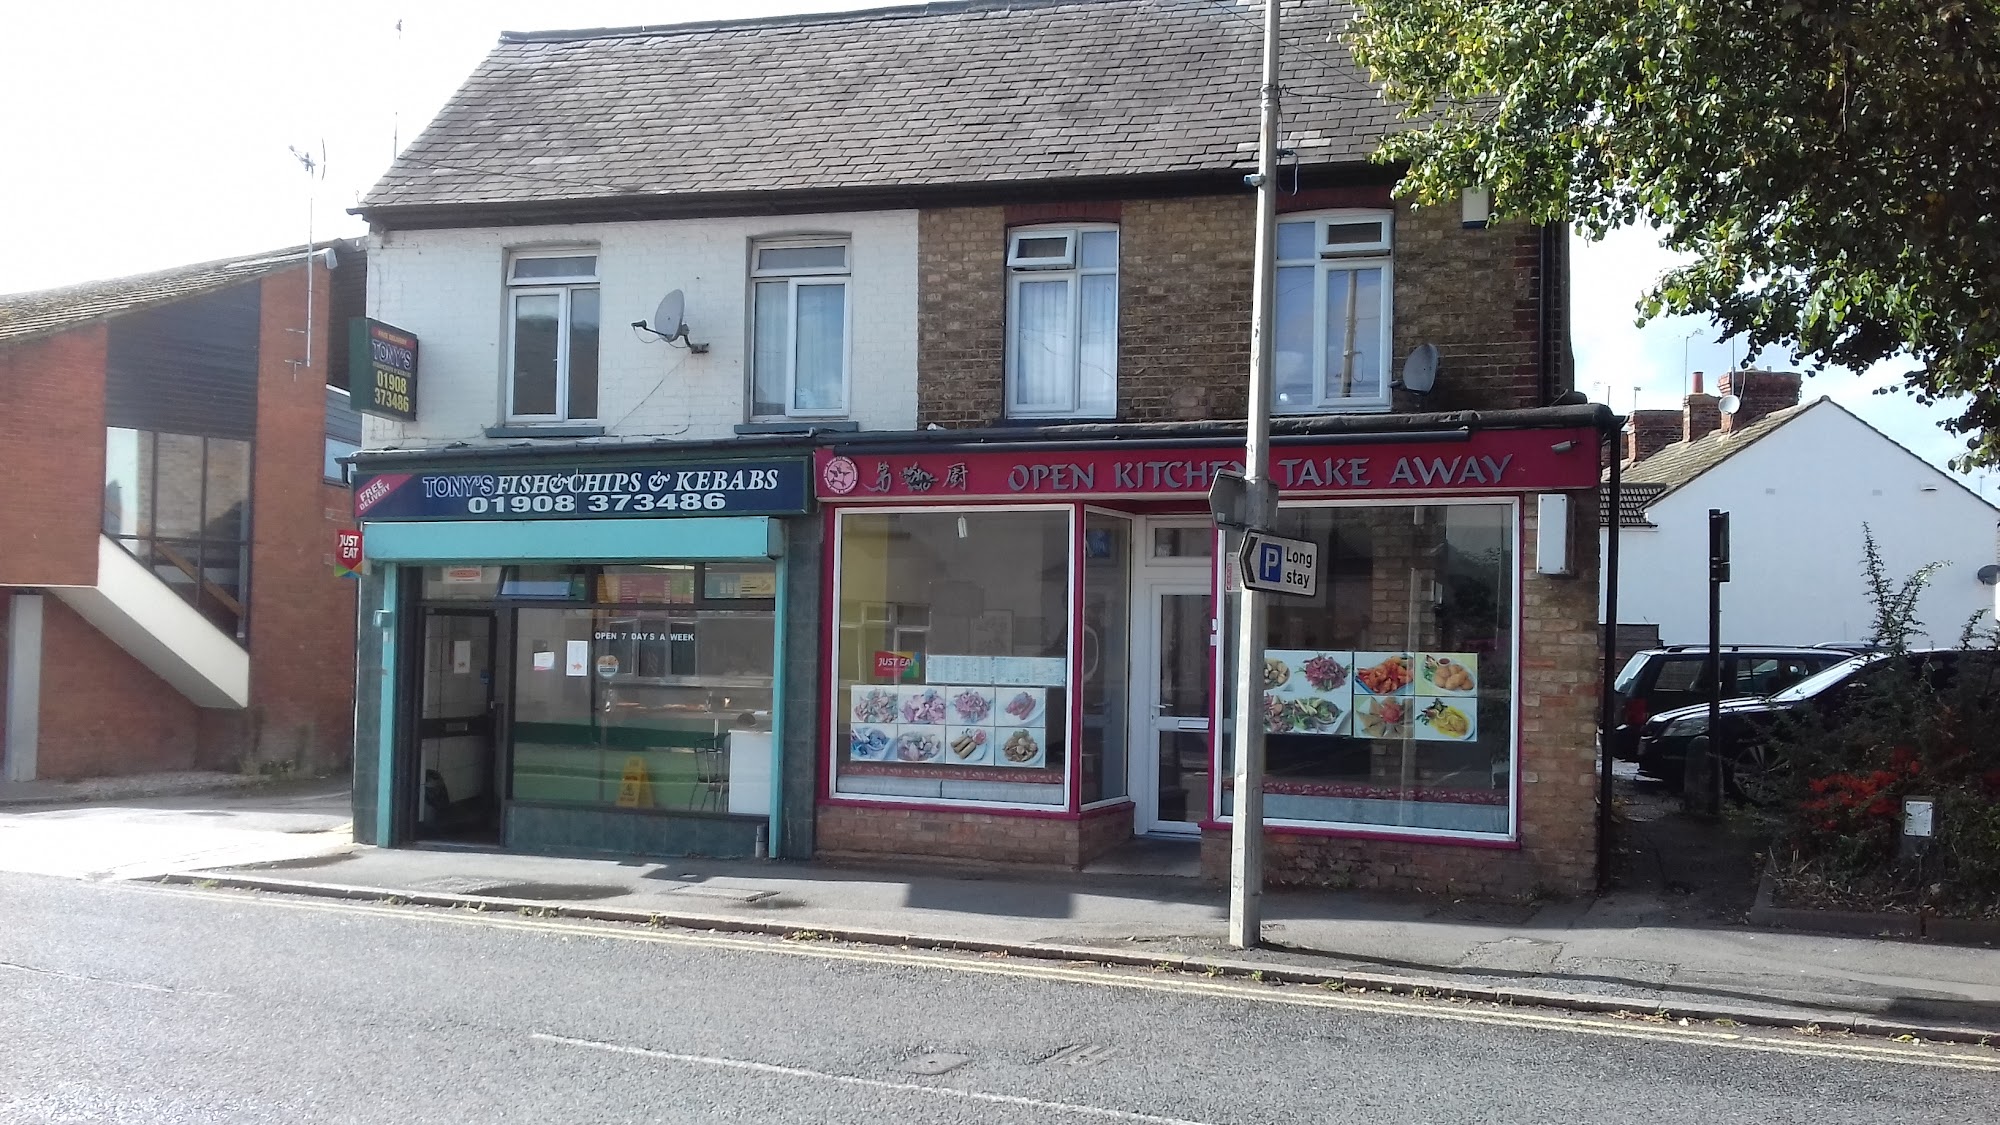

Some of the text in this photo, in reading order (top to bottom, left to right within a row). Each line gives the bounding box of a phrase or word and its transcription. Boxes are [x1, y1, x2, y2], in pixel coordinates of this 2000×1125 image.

[372, 339, 412, 371] TONY'S
[377, 370, 407, 395] 01908
[374, 387, 410, 413] 373486
[422, 475, 496, 498] TONY'S
[648, 471, 671, 492] &
[673, 469, 779, 493] KEBABS
[1008, 462, 1095, 491] OPEN
[1277, 457, 1372, 488] TAKE
[1389, 453, 1514, 487] AWAY
[359, 483, 390, 511] DELIVERY
[360, 479, 384, 502] FREE
[468, 492, 726, 514] 01908 373486
[339, 534, 360, 548] JUST
[343, 547, 360, 559] EAT
[1286, 546, 1312, 569] Long
[1286, 569, 1310, 589] stay
[594, 632, 695, 641] OPEN 7 DAYS A WEEK
[878, 657, 914, 667] JUST EAT
